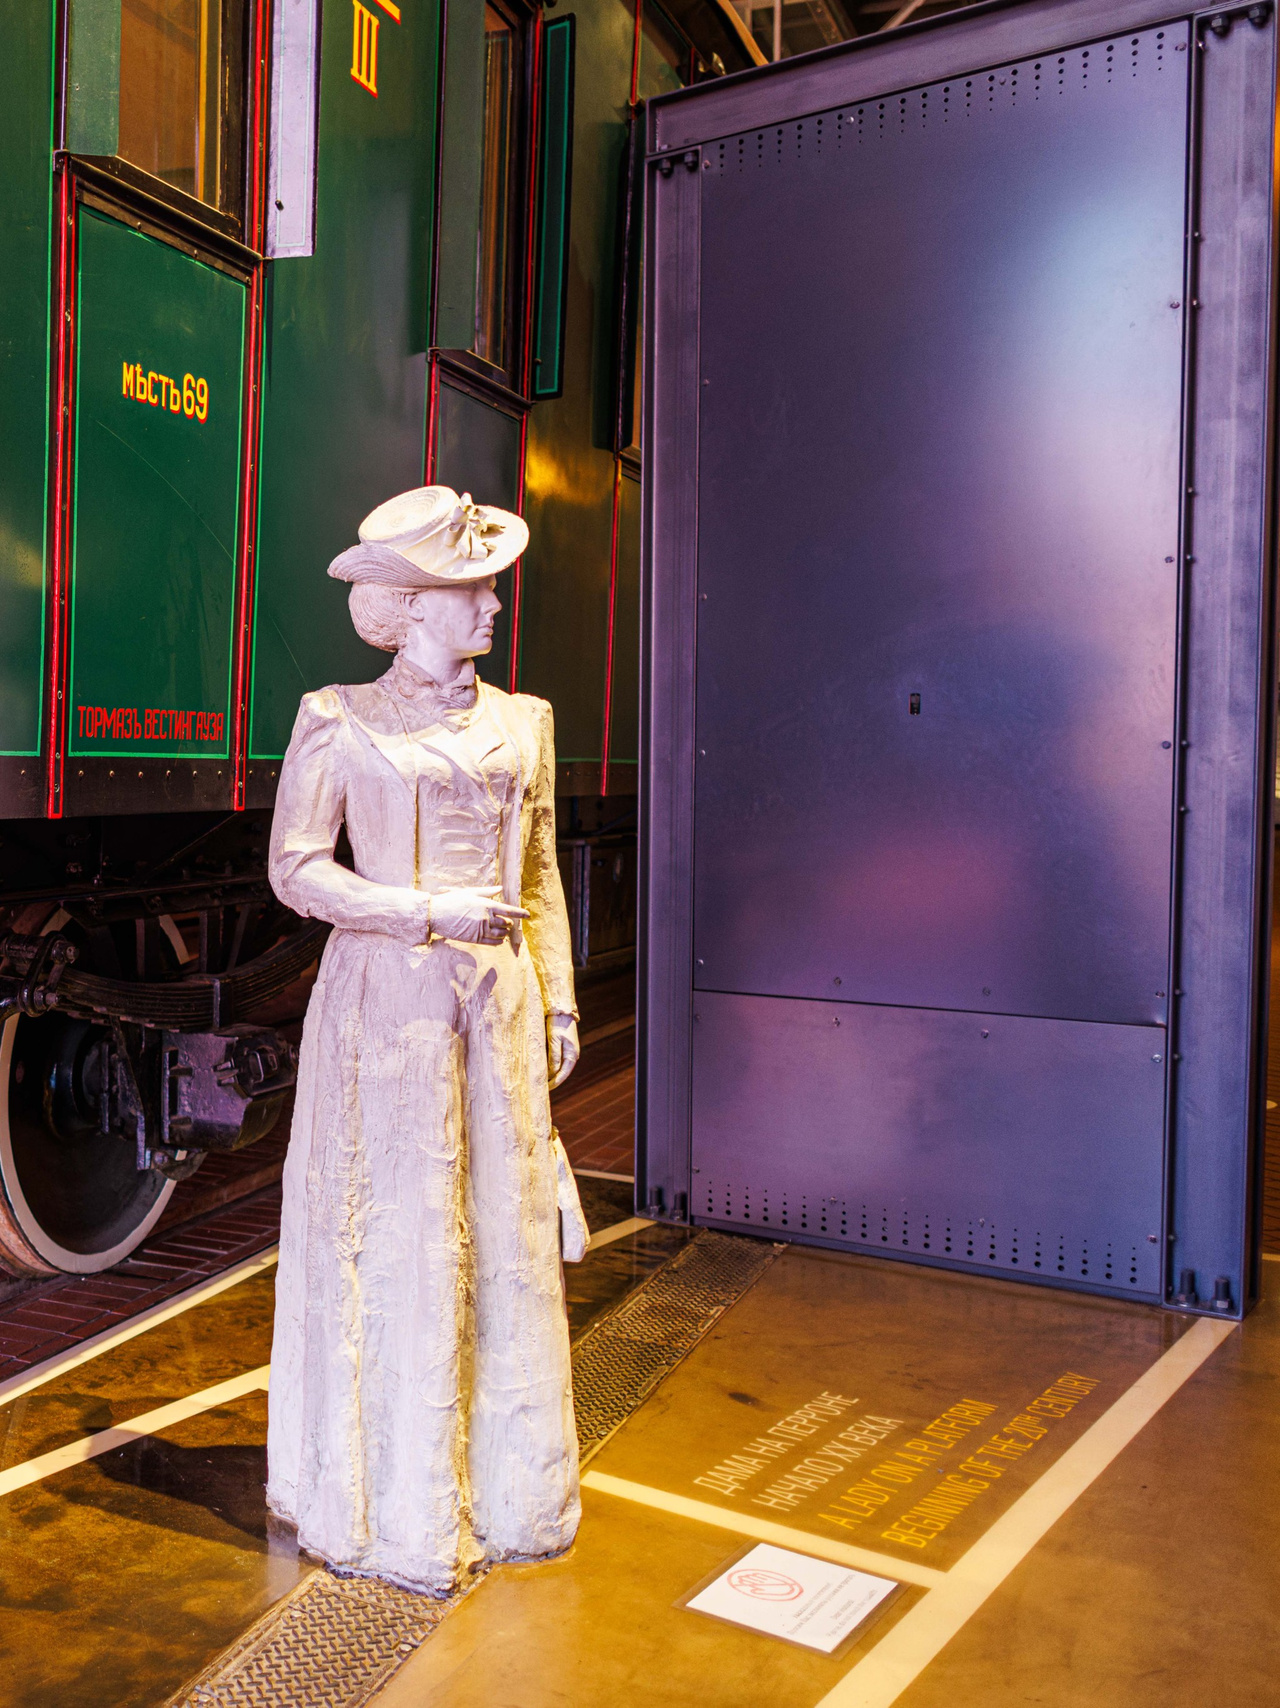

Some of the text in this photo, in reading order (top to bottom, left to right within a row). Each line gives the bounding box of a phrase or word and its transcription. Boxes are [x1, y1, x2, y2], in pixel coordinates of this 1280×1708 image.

[182, 372, 209, 425] 69
[77, 705, 224, 741] ТОРМАЗЪ ВЕСТИНГАУЗА
[1026, 1371, 1101, 1418] CENTURY
[693, 1390, 859, 1497] ДАМА НА ПЕРРОНЕ
[751, 1458, 844, 1512] НАЧАЛО
[838, 1414, 904, 1447] ВЕКА
[818, 1398, 999, 1530] A LADY ON A PLATFORM
[976, 1434, 1034, 1461] THE
[958, 1456, 1007, 1485] OF
[881, 1474, 990, 1548] BEGINNING
